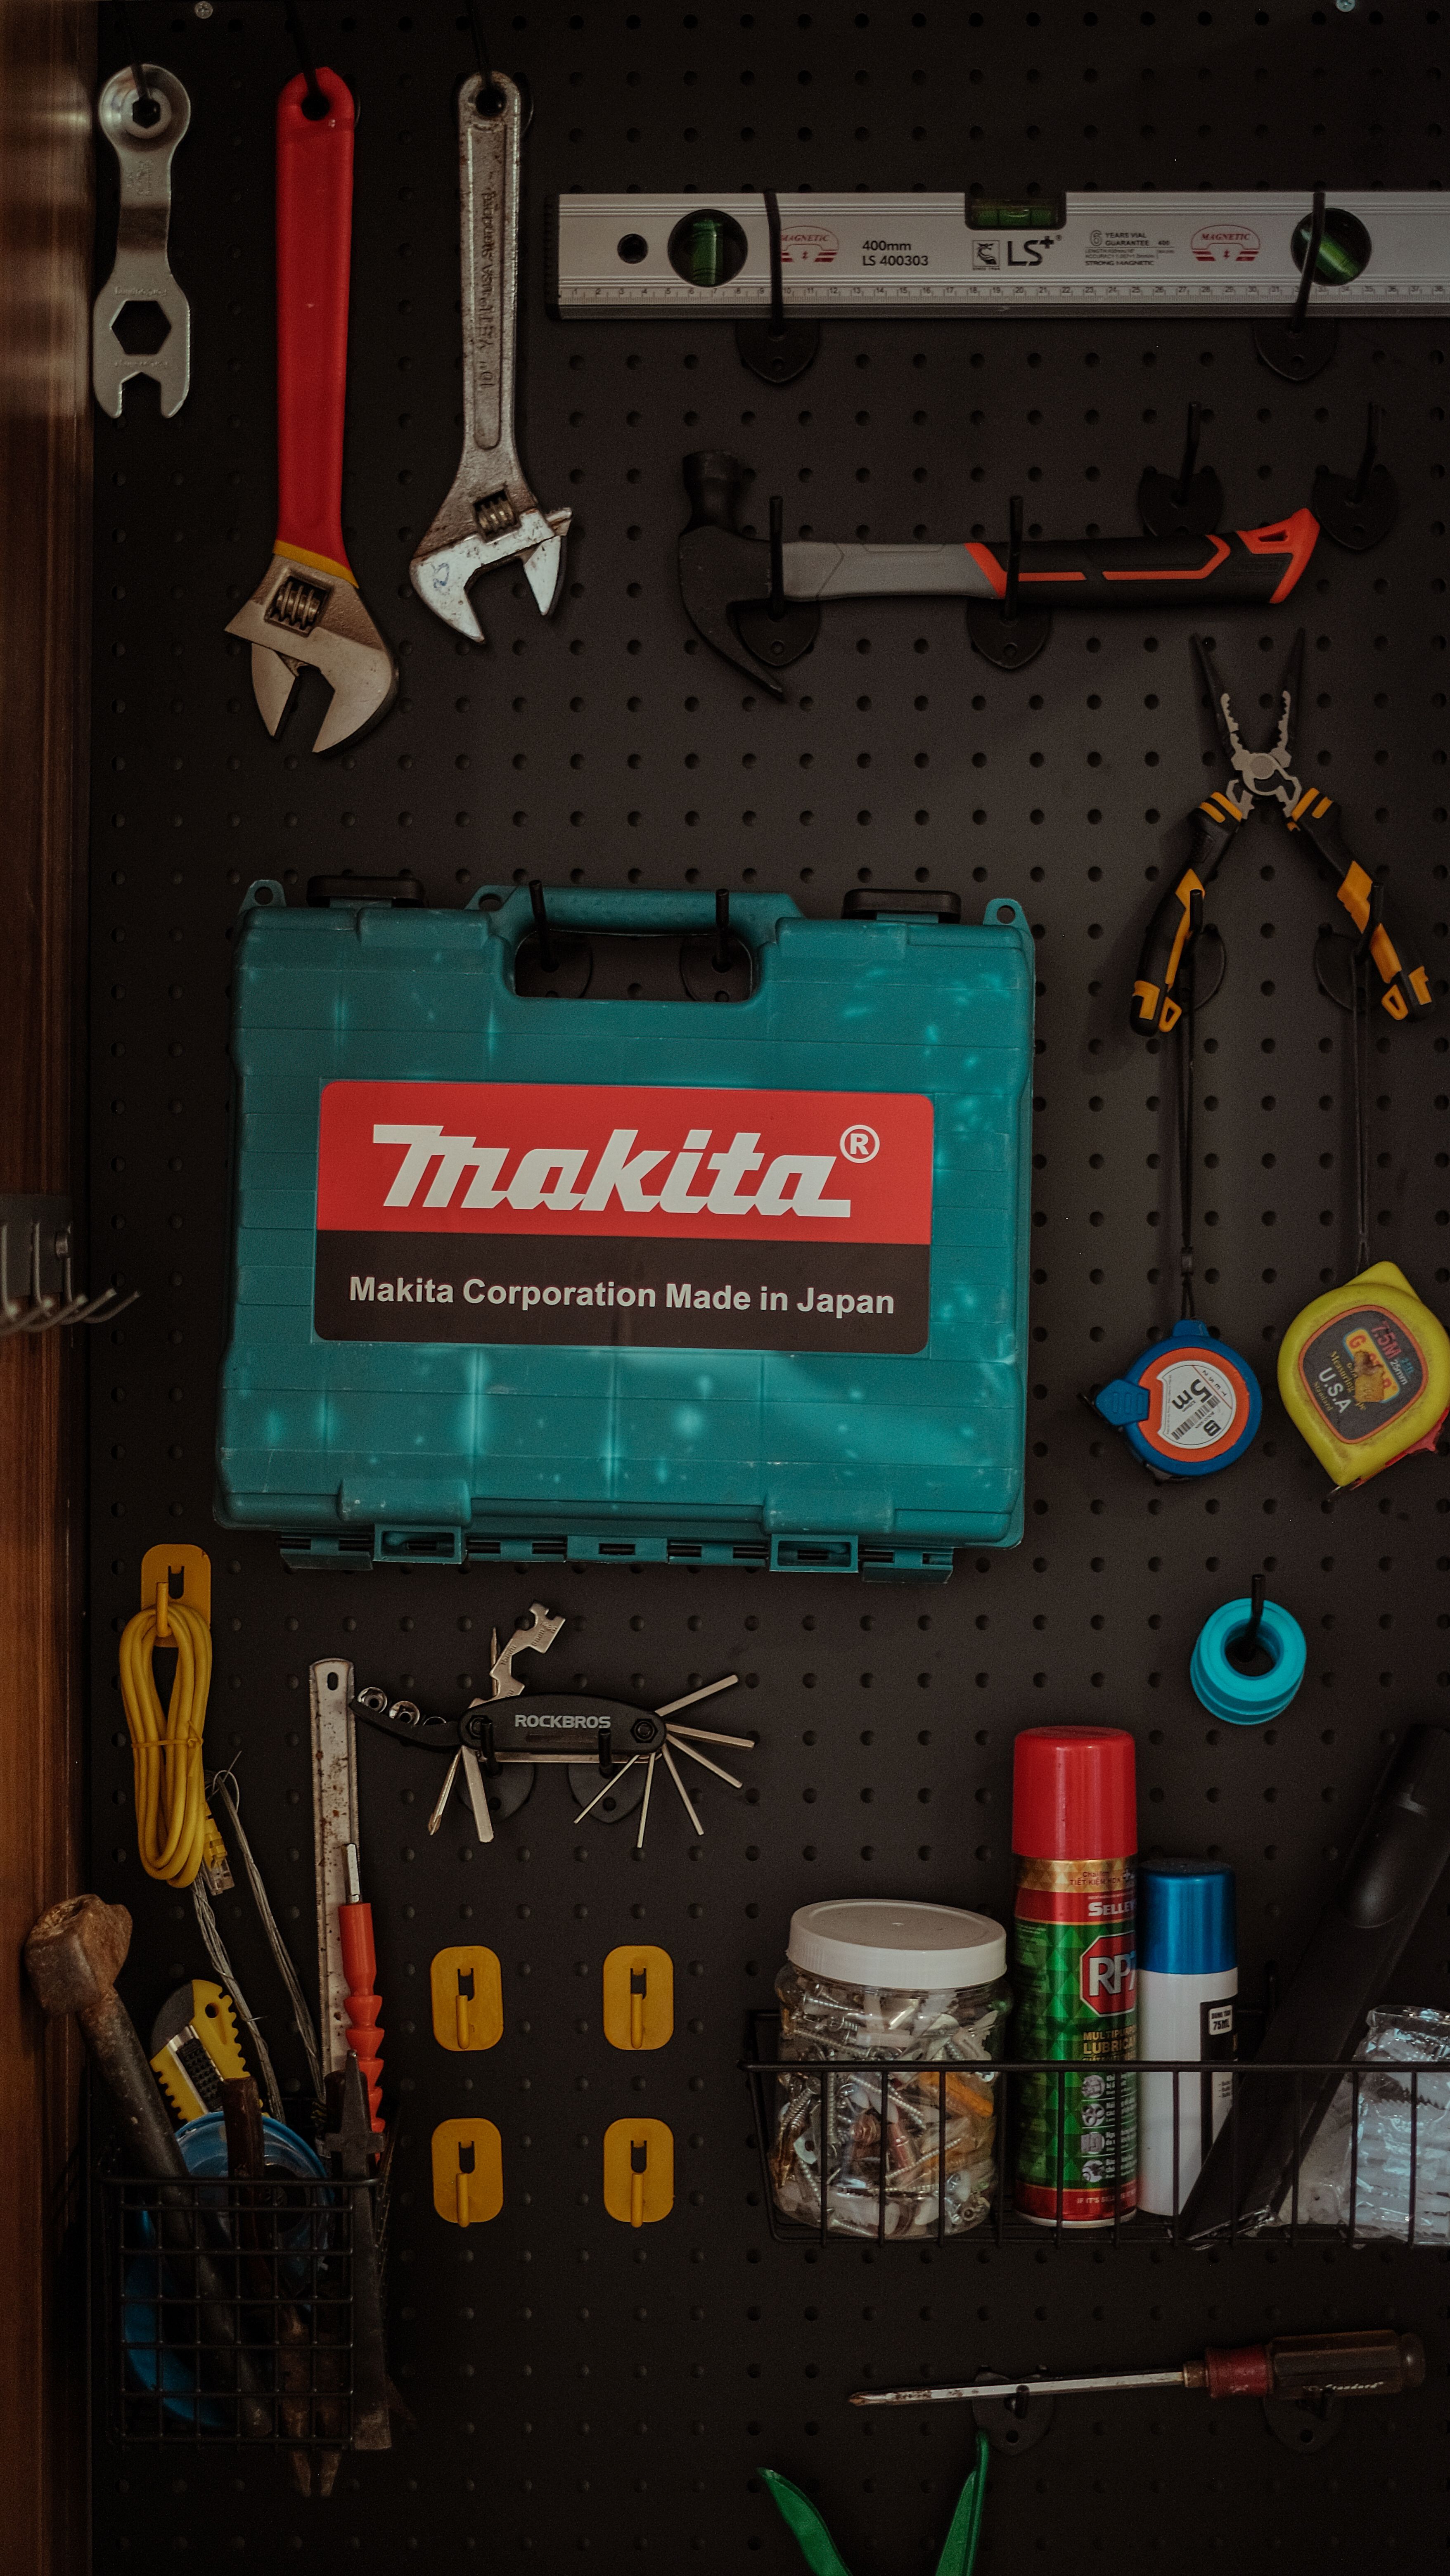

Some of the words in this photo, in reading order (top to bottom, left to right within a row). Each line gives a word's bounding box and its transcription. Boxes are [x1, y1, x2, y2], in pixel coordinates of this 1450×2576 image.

[862, 240, 911, 251] 400mm
[862, 256, 876, 266] LS
[879, 255, 929, 266] 400303
[349, 1276, 454, 1304] Makita
[462, 1278, 656, 1311] Corporation
[666, 1283, 751, 1311] Made
[760, 1286, 788, 1311] in
[797, 1288, 895, 1320] Japan
[1171, 1378, 1213, 1411] 5m
[1318, 1367, 1352, 1414] U.S.A
[514, 1714, 611, 1729] ROCKBROS
